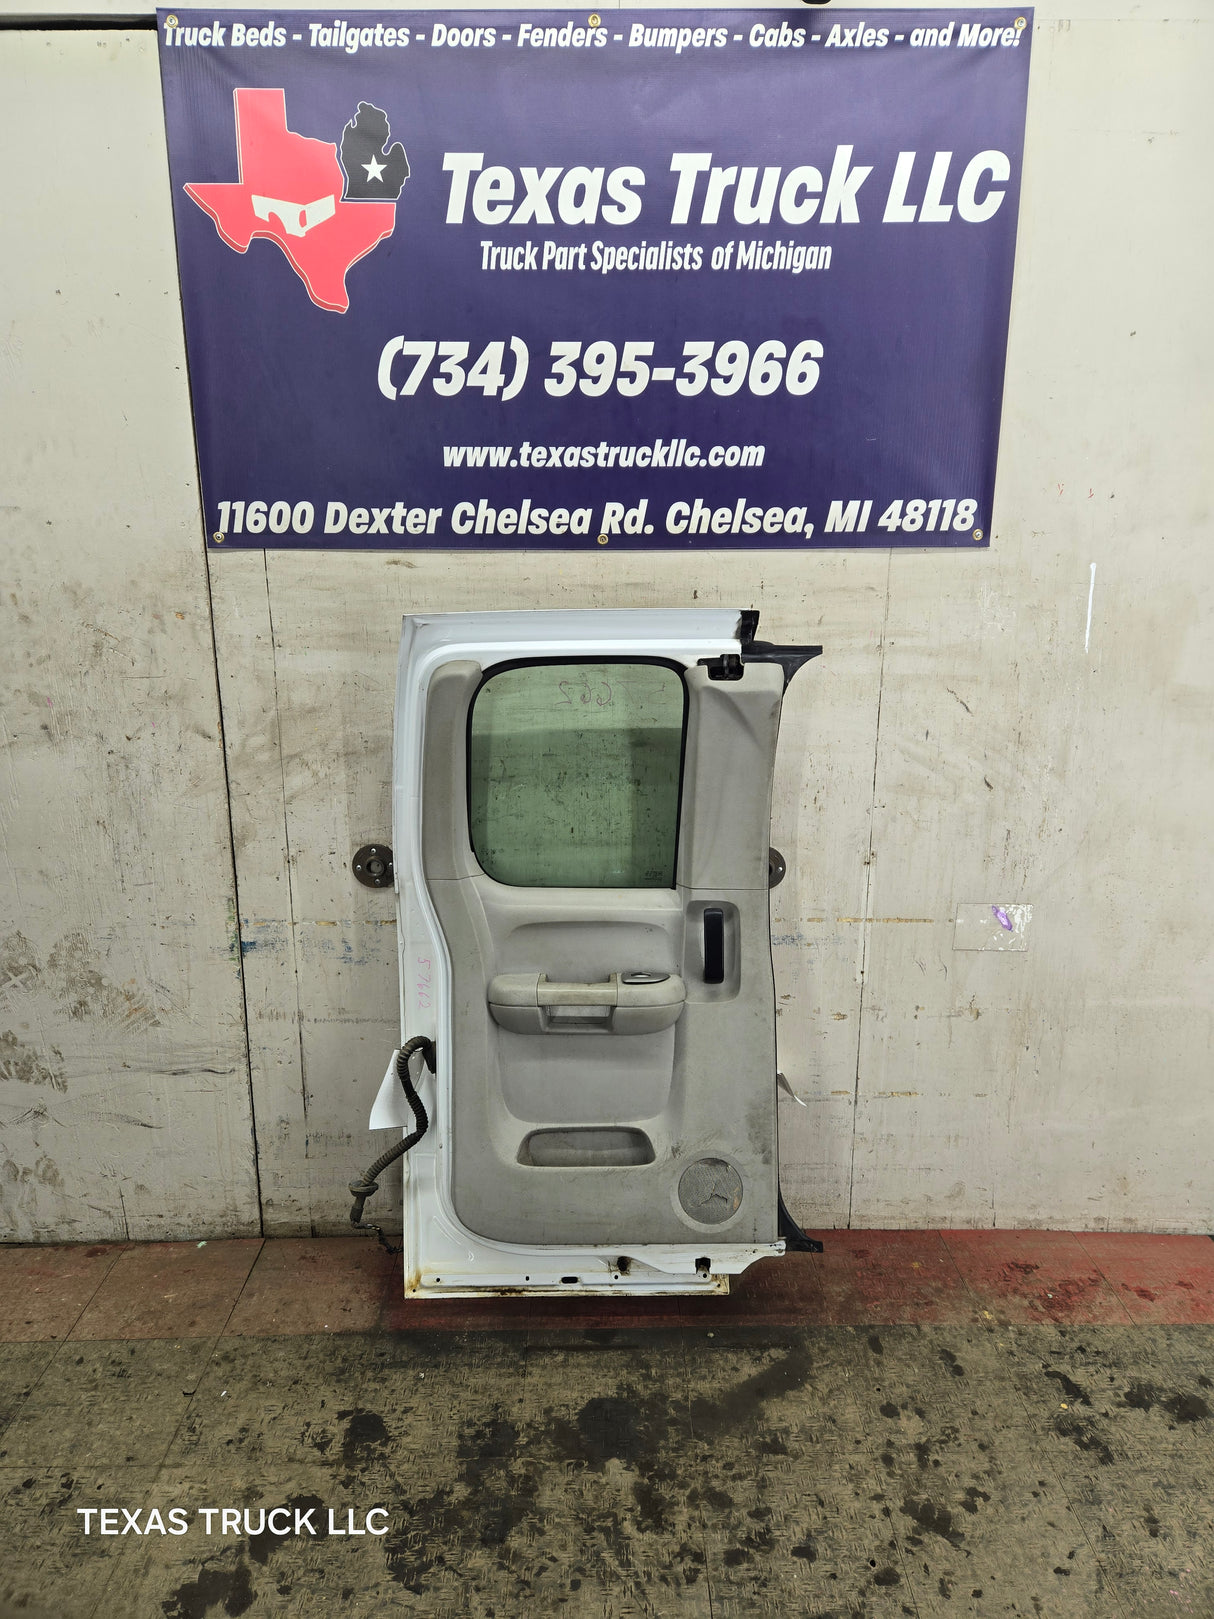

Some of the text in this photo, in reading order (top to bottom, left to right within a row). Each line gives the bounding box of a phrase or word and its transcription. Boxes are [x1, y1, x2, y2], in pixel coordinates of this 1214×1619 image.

[163, 21, 227, 47] Truck
[231, 20, 287, 47] Beds
[292, 33, 303, 41] -
[309, 20, 410, 54] Tailgates
[416, 33, 426, 41] -
[431, 23, 497, 48] Doors
[502, 33, 512, 41] -
[517, 21, 608, 48] Fenders
[613, 33, 623, 41] -
[628, 23, 728, 54] Bumpers
[733, 34, 743, 42] -
[748, 21, 806, 48] Cabs
[825, 22, 890, 48] Axles
[910, 21, 956, 48] and
[956, 23, 1023, 48] More!
[441, 144, 1011, 226] Texas Truck LLC
[480, 240, 833, 275] Truck Part Specialists of Michigan
[377, 335, 824, 402] (734) 395-3966
[443, 438, 766, 468] www.texastruckllc.com
[216, 498, 978, 539] 11600 Dexter Chelsea Rd. Chelsea, MI 48118
